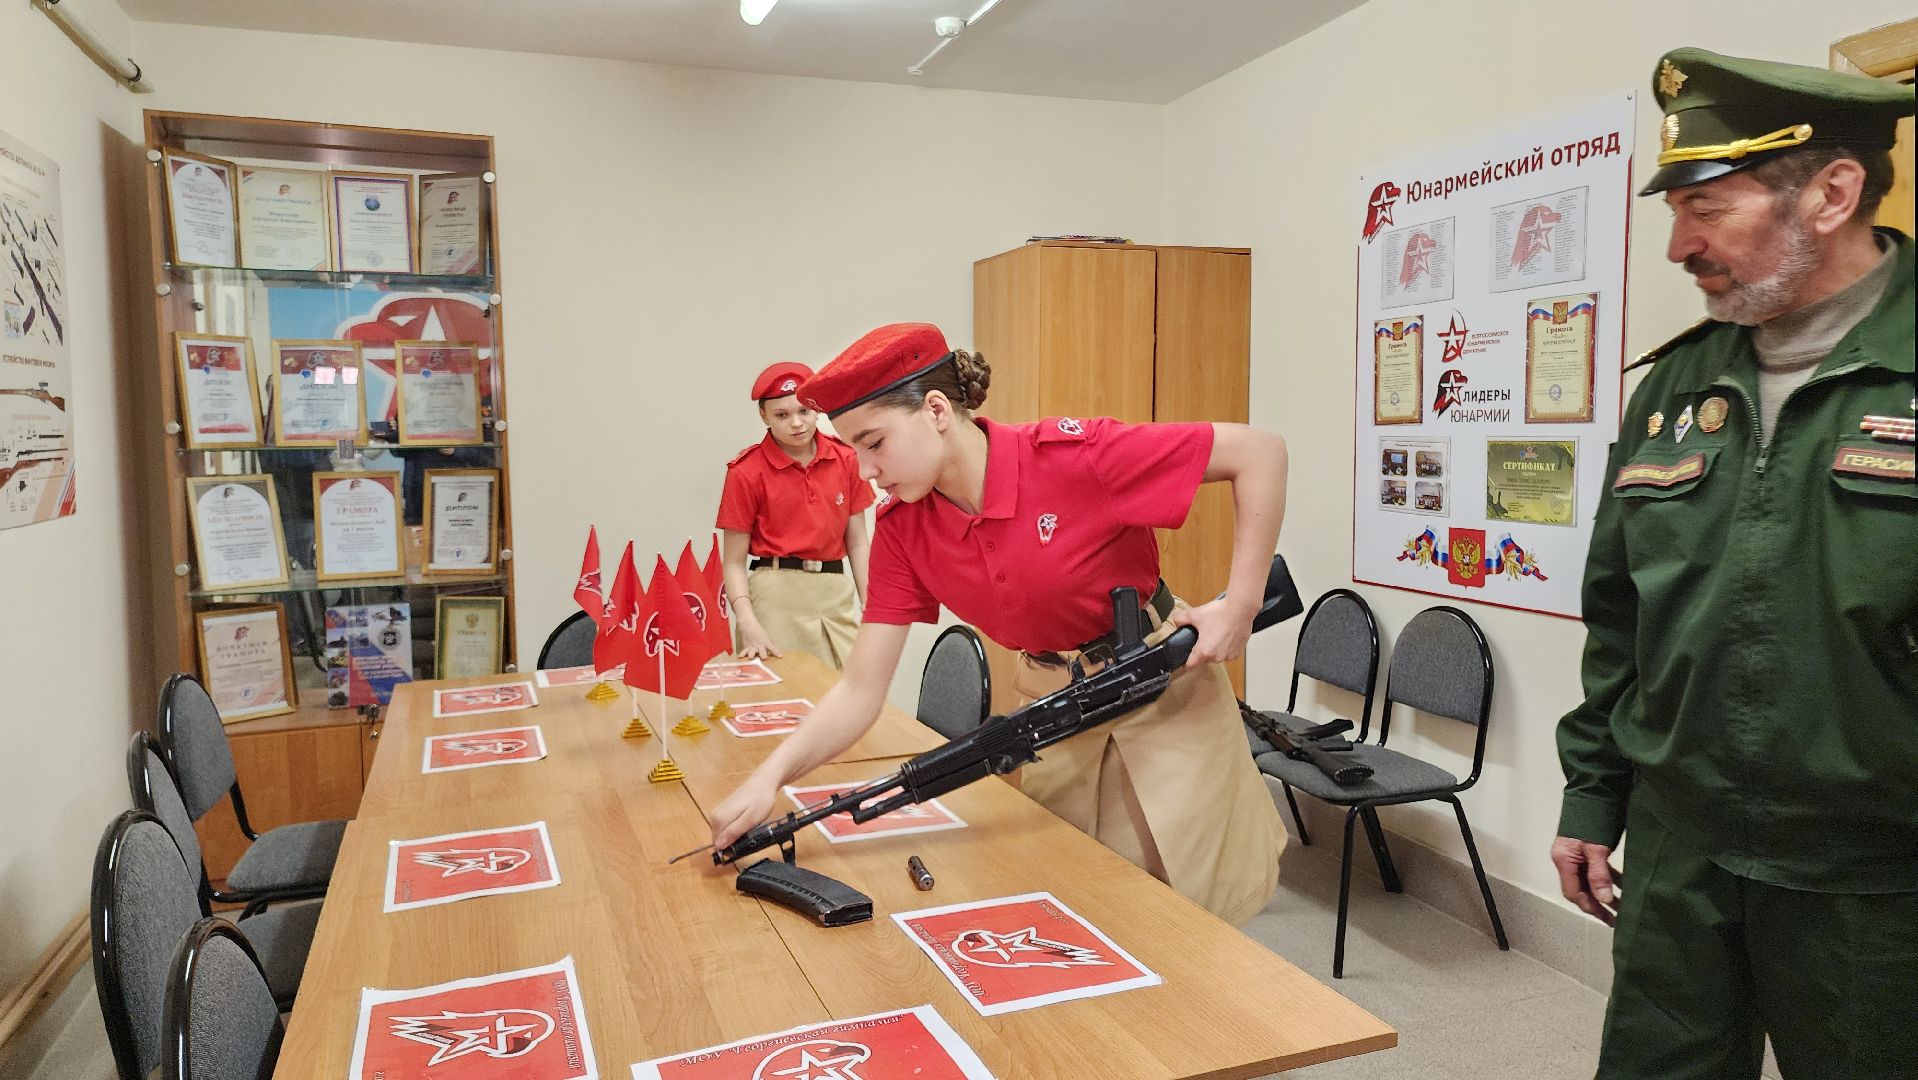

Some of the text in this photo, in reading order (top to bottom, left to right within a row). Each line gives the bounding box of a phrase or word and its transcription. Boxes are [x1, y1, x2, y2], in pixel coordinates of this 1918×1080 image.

[1406, 130, 1621, 205] Юнармейский отряд
[1546, 324, 1574, 335] Грамота
[1463, 388, 1511, 404] ЛИДЕРЫ
[1450, 408, 1510, 424] ЮНАРМИИ
[1502, 461, 1556, 473] СЕРТИФИКАТ
[680, 1052, 723, 1068] МОУ
